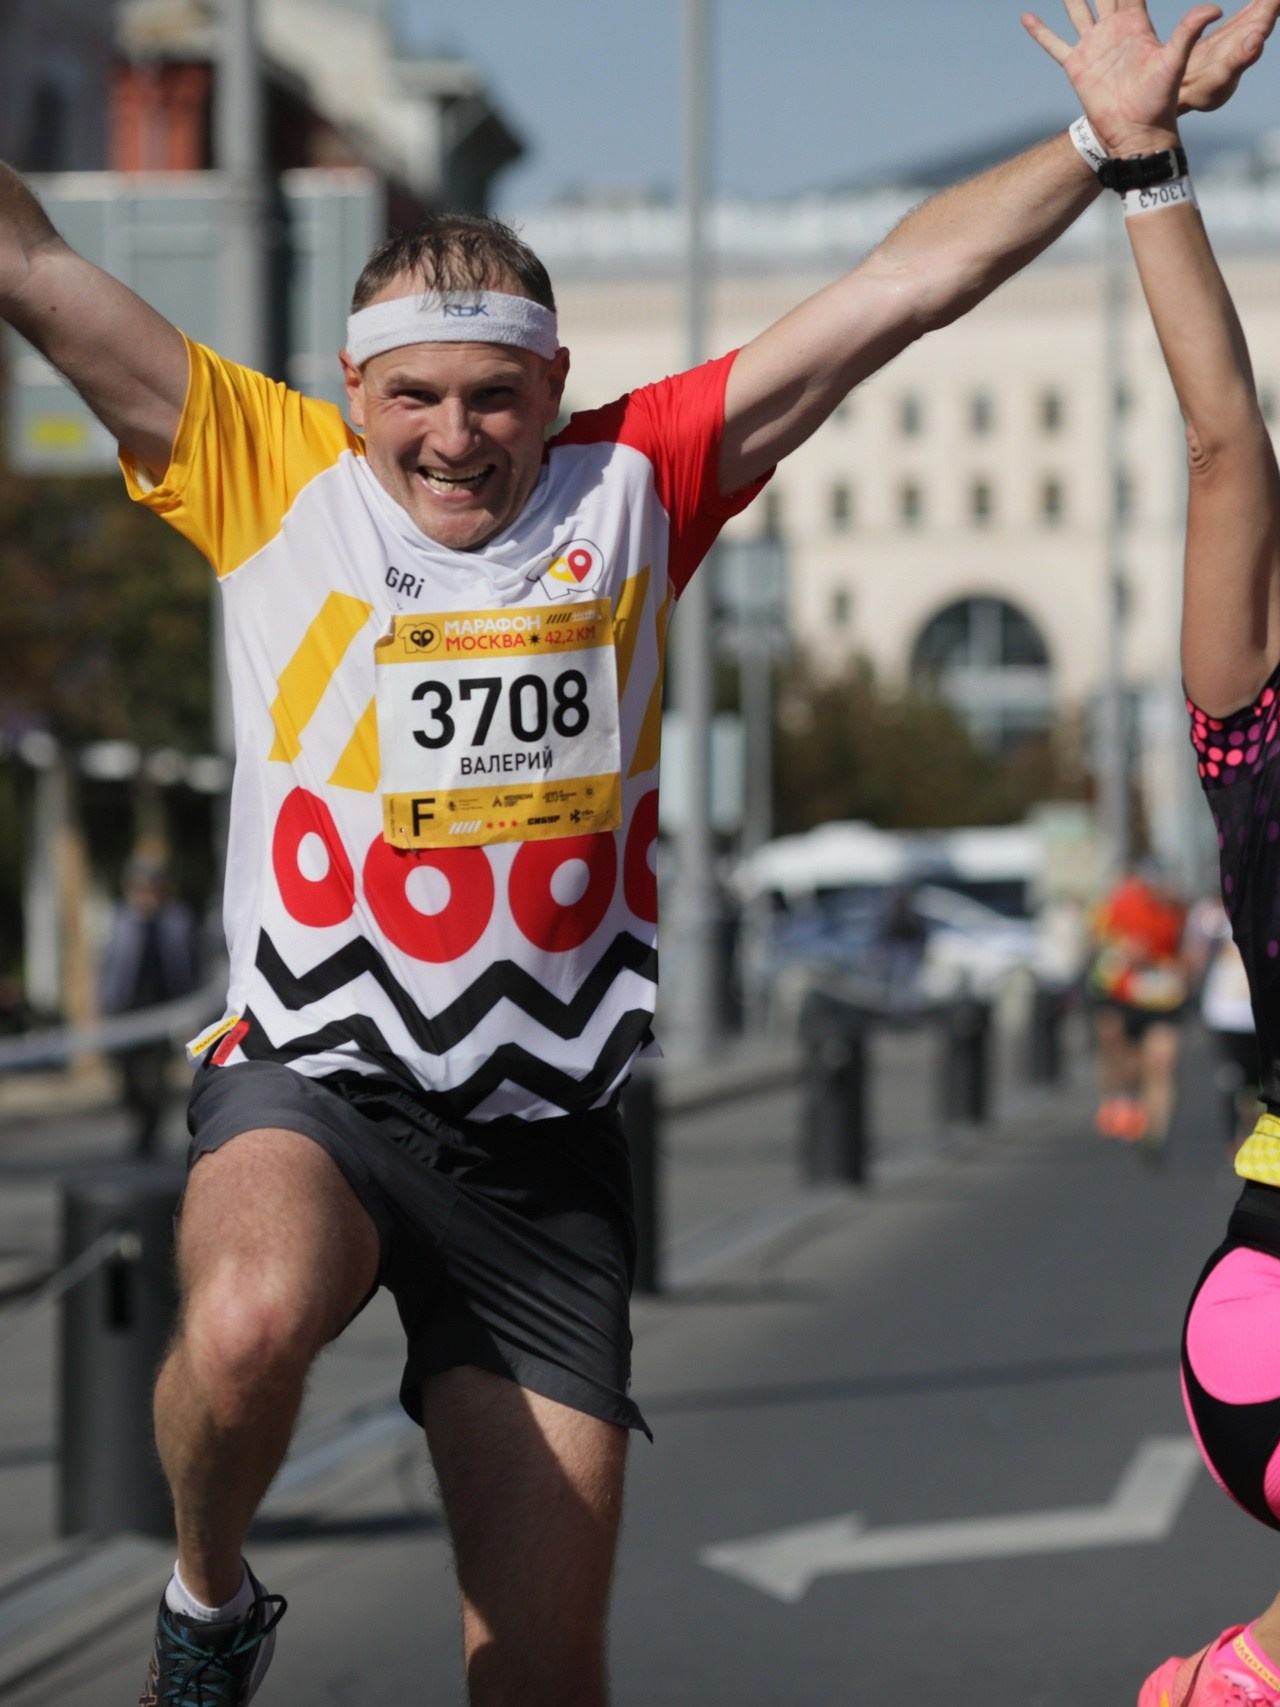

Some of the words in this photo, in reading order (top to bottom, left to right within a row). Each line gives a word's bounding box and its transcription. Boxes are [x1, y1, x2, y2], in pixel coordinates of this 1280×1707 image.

[1138, 183, 1186, 208] 13043
[385, 566, 425, 599] GRi
[444, 615, 541, 635] МАРАФОН
[445, 633, 527, 651] МОСКВА
[544, 628, 573, 645] 42,2
[576, 625, 596, 642] КМ
[411, 669, 590, 750] 3708
[460, 745, 553, 776] ВАЛЕРИЙ
[411, 798, 436, 837] F
